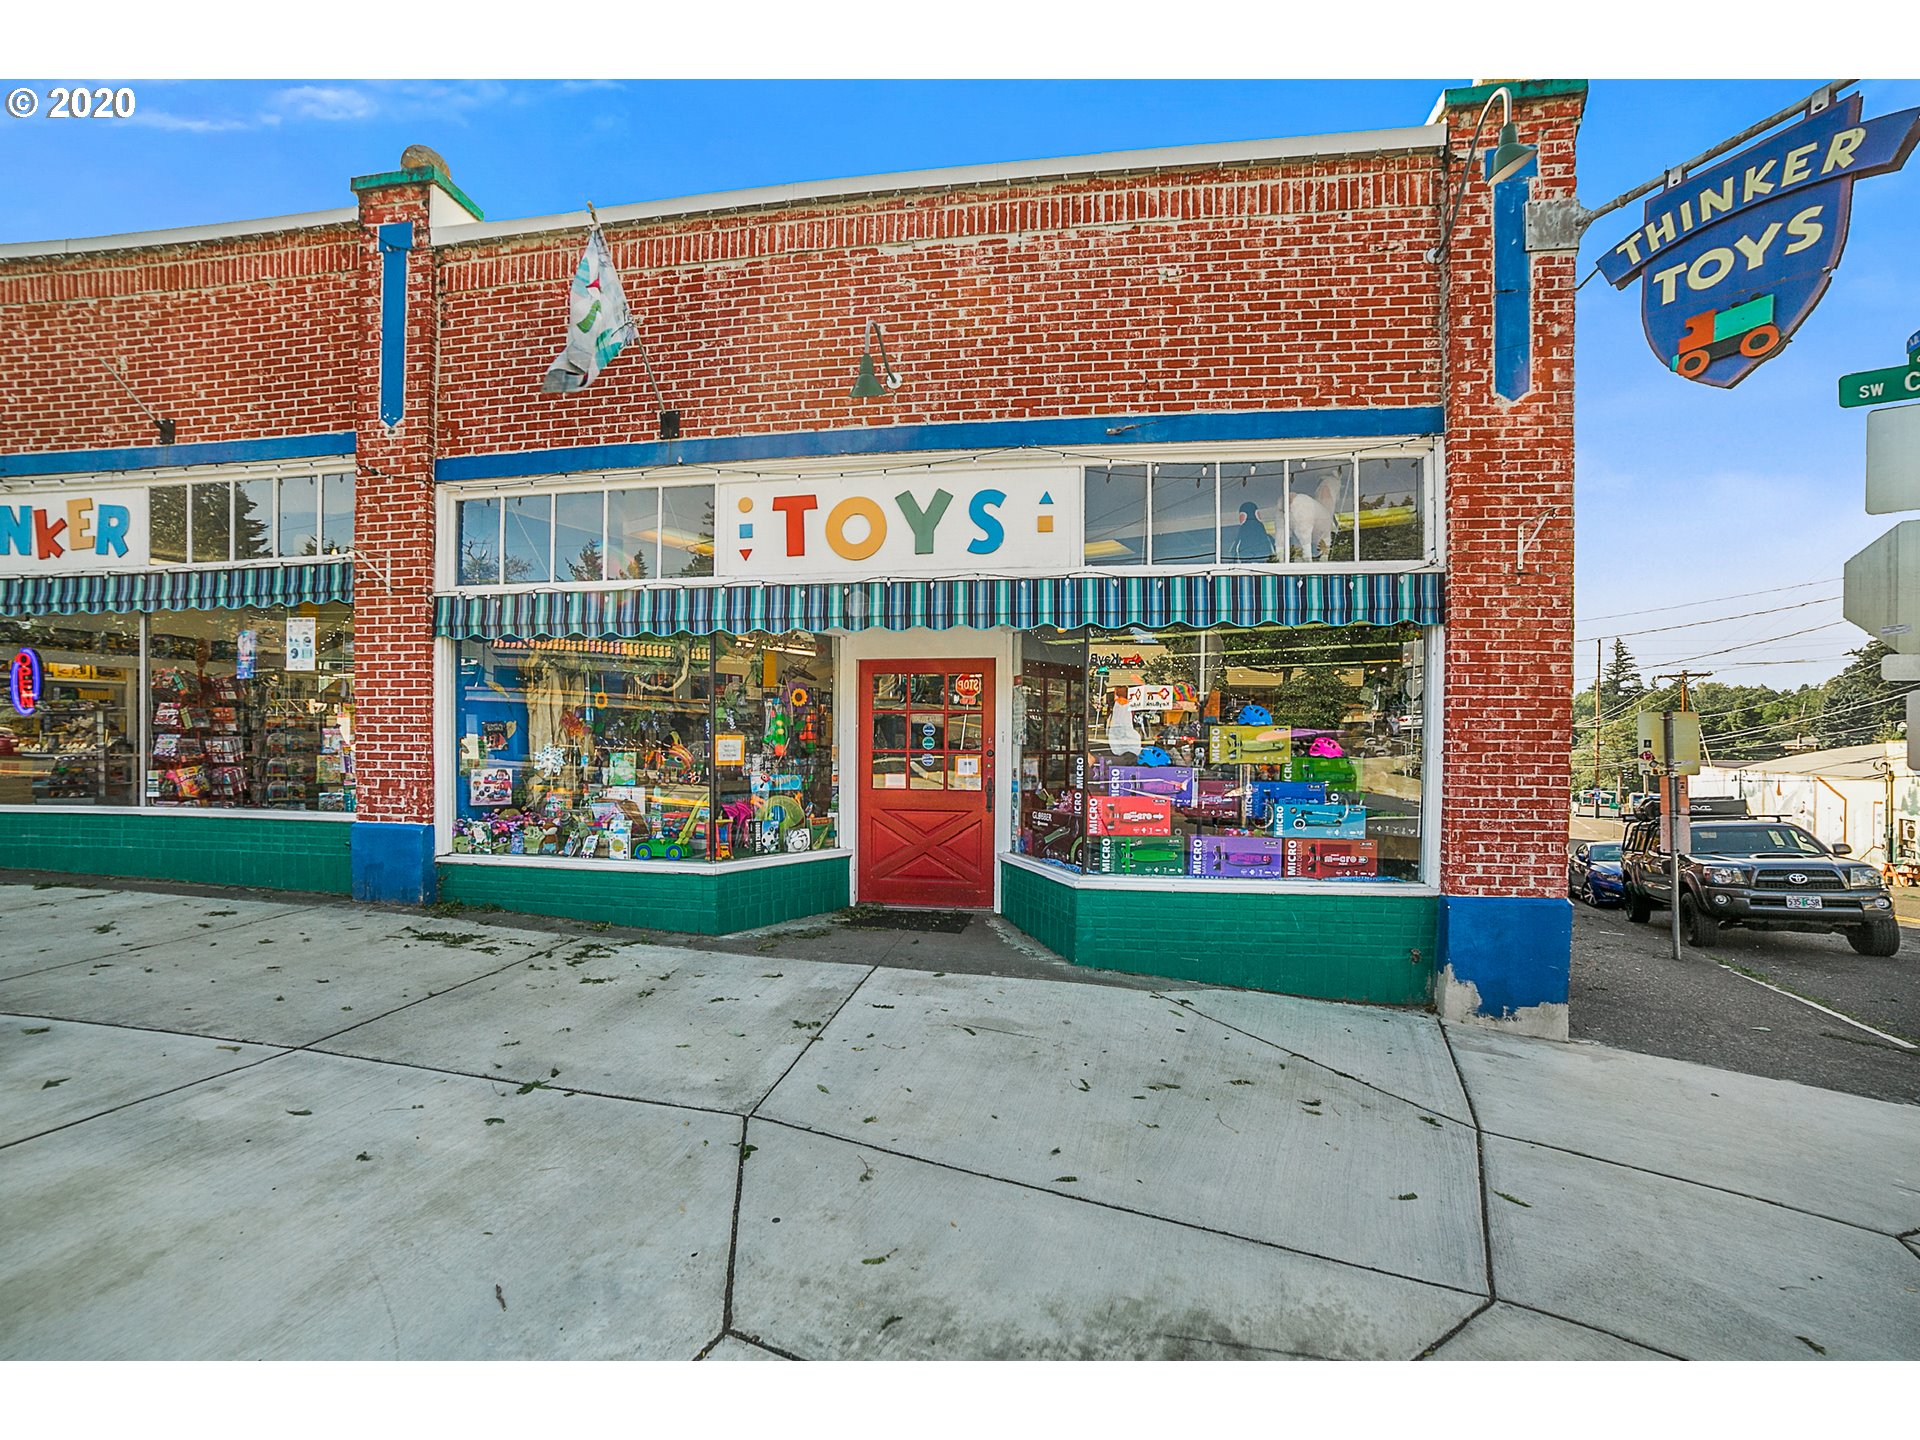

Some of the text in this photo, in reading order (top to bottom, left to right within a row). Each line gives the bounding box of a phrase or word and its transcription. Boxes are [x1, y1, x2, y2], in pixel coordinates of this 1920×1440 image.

[1616, 127, 1867, 265] THINKER
[1652, 205, 1825, 305] TOYS
[1859, 383, 1884, 398] SW
[0, 497, 130, 560] NKER
[772, 488, 1007, 562] TOYS
[15, 652, 35, 708] OPEN
[1211, 728, 1220, 762] MICRO
[1076, 757, 1084, 789] MICRO
[1074, 792, 1082, 814] ICRO
[1089, 798, 1098, 834] MICRO
[1276, 805, 1284, 836] MICRO
[1102, 838, 1111, 873] MICRO
[1192, 839, 1202, 874] MICRO
[1287, 840, 1297, 876] MICRO
